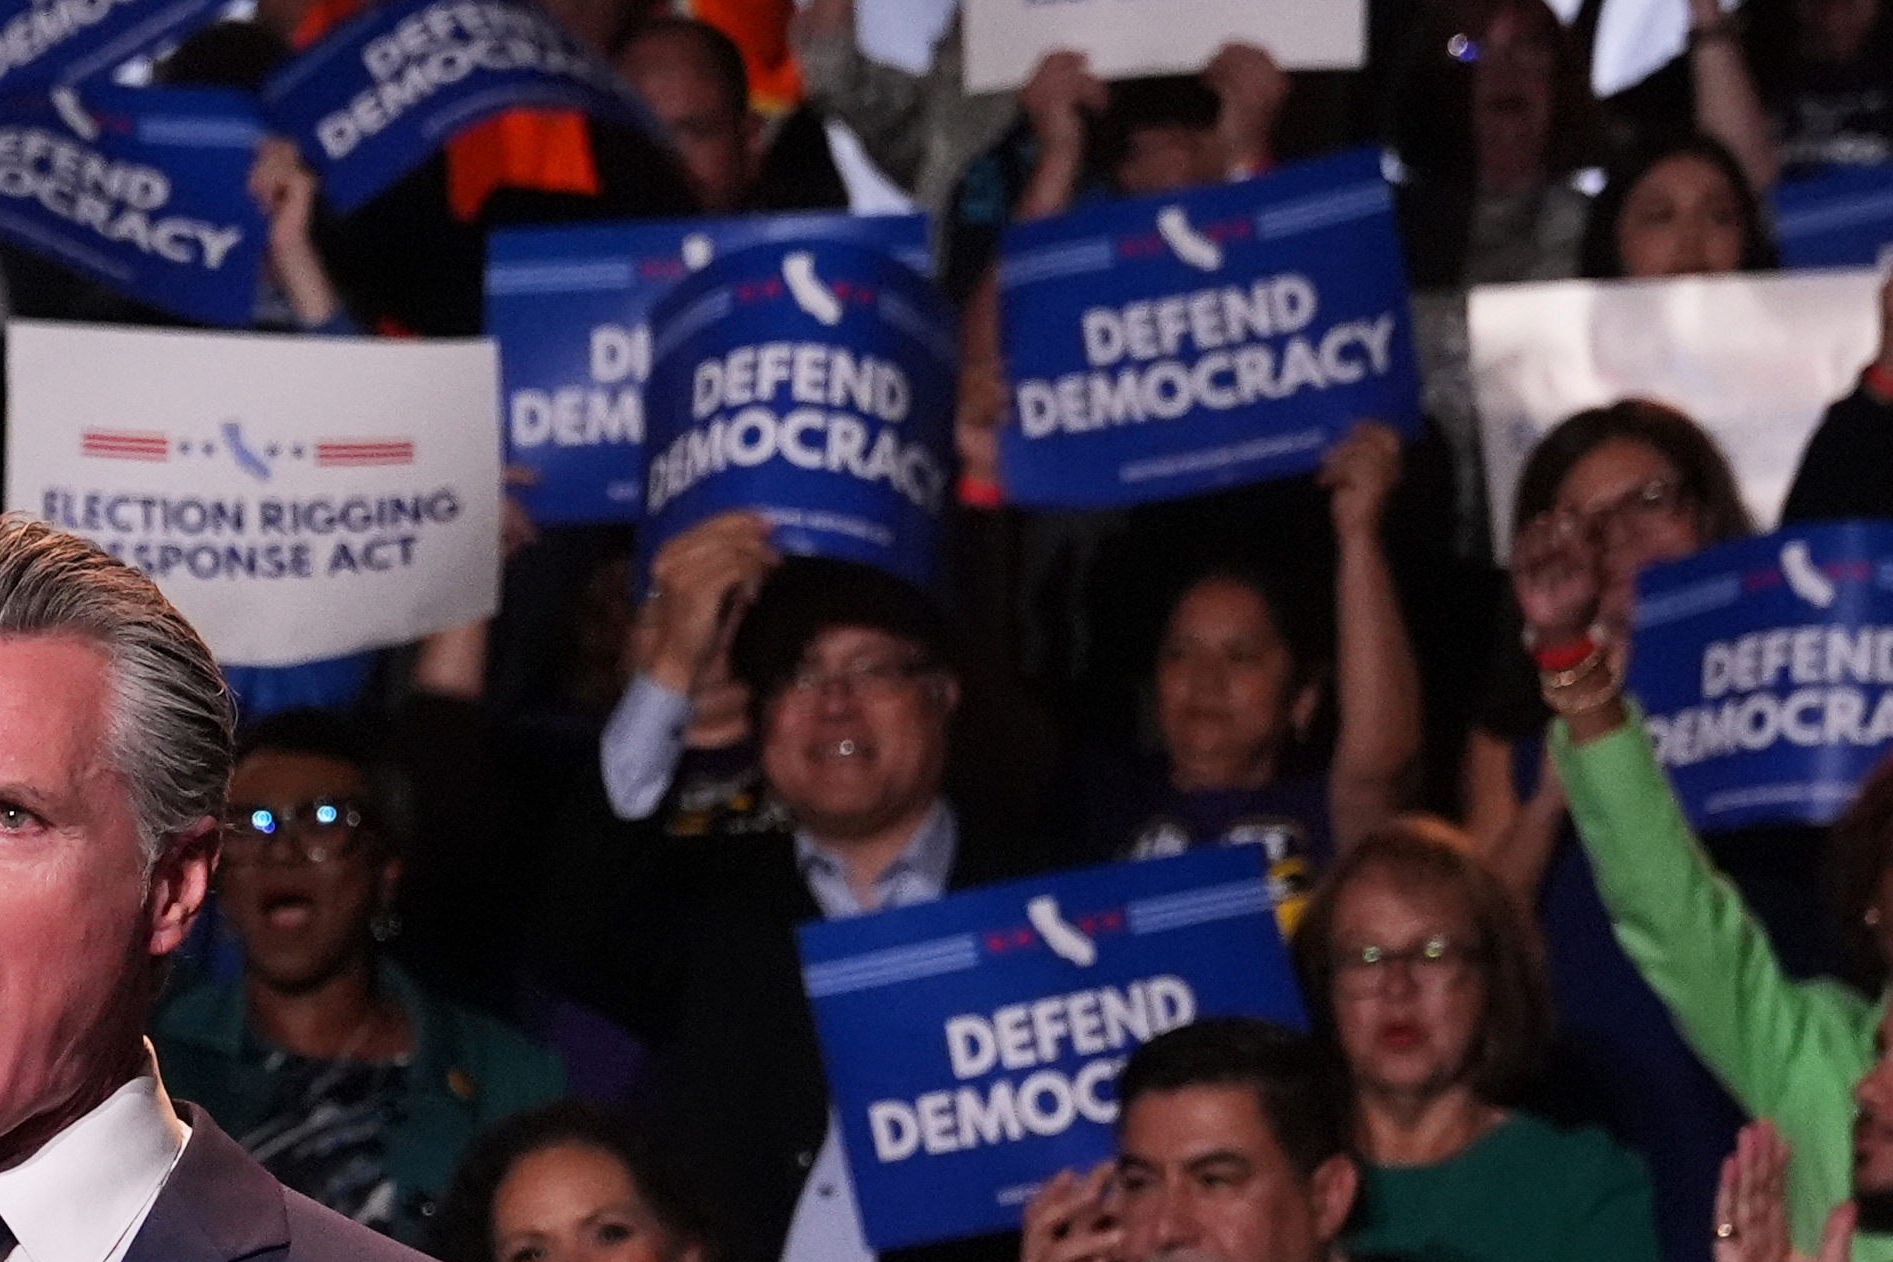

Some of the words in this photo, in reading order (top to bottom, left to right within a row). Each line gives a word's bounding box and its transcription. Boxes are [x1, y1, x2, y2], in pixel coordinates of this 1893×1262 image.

[1082, 272, 1316, 367] DEFEND
[693, 340, 910, 422] DEFEND
[1018, 313, 1394, 438] DEMOCRACY
[41, 487, 244, 535] ELECTION
[258, 487, 460, 535] RIGGING
[326, 536, 417, 577] ACT
[1645, 686, 1893, 768] DEMOCRA
[945, 973, 1196, 1080] DEFEND
[867, 1055, 1126, 1164] DEMOC
